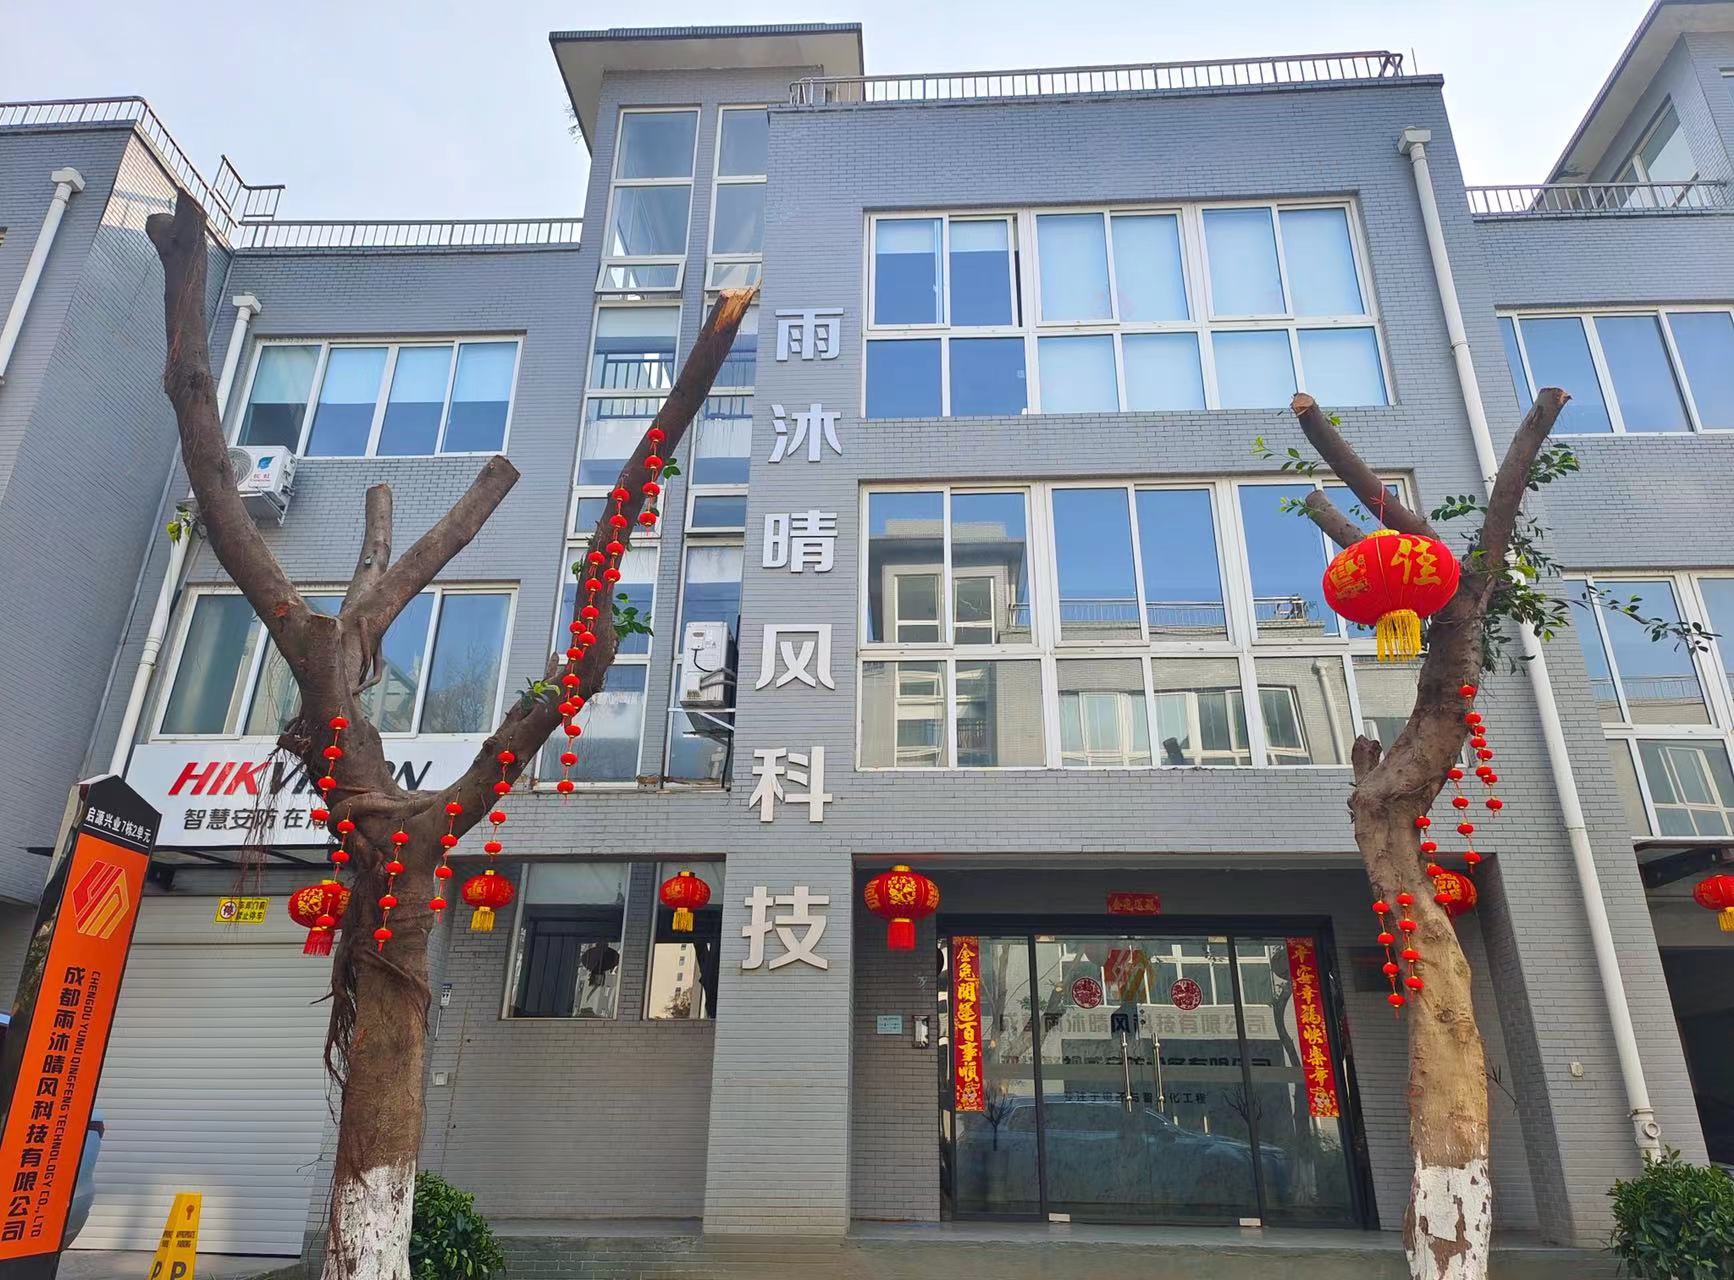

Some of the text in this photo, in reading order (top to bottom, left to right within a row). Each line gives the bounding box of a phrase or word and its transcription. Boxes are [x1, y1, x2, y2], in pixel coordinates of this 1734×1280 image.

[1390, 538, 1442, 585] 佳
[741, 307, 845, 971] 雨沐晴风科技
[82, 971, 101, 1021] CHENGDU
[74, 1022, 89, 1054] YUMU
[1, 966, 86, 1242] 成都雨沐晴风科技有限公司
[61, 1055, 81, 1111] QINGFENG
[42, 1112, 67, 1188] TECHNOLOGY
